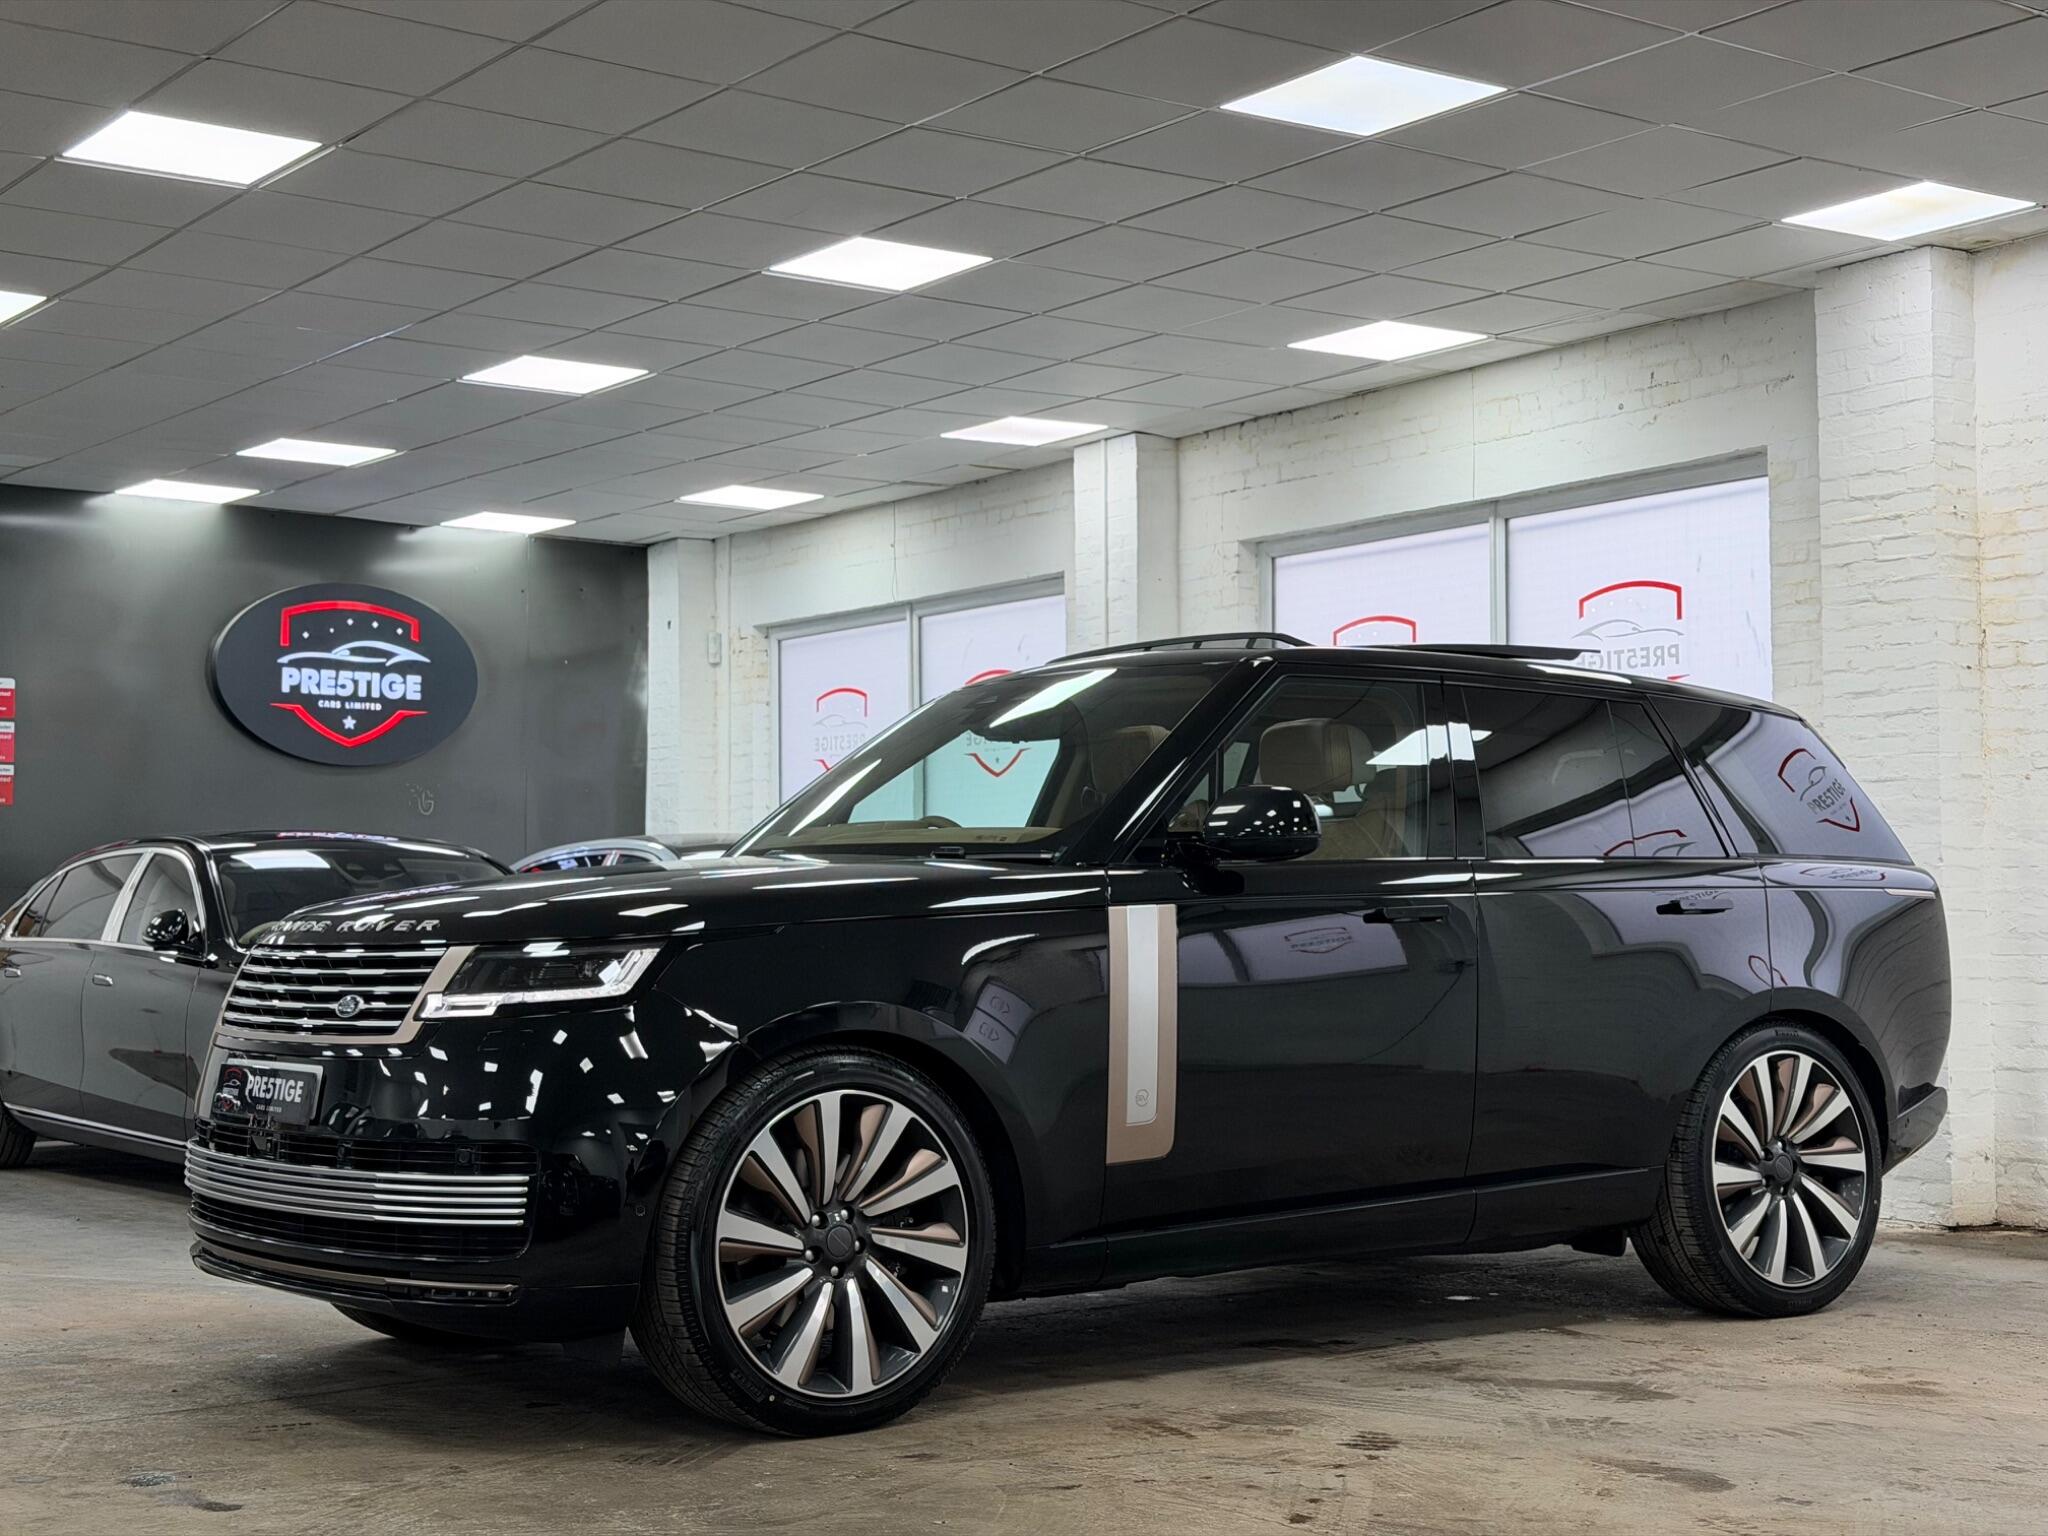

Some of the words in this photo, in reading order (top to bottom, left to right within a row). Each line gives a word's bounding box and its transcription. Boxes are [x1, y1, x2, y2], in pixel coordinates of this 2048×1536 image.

[318, 699, 342, 709] CARS
[345, 701, 382, 711] LIMITED
[336, 919, 441, 932] ROVER
